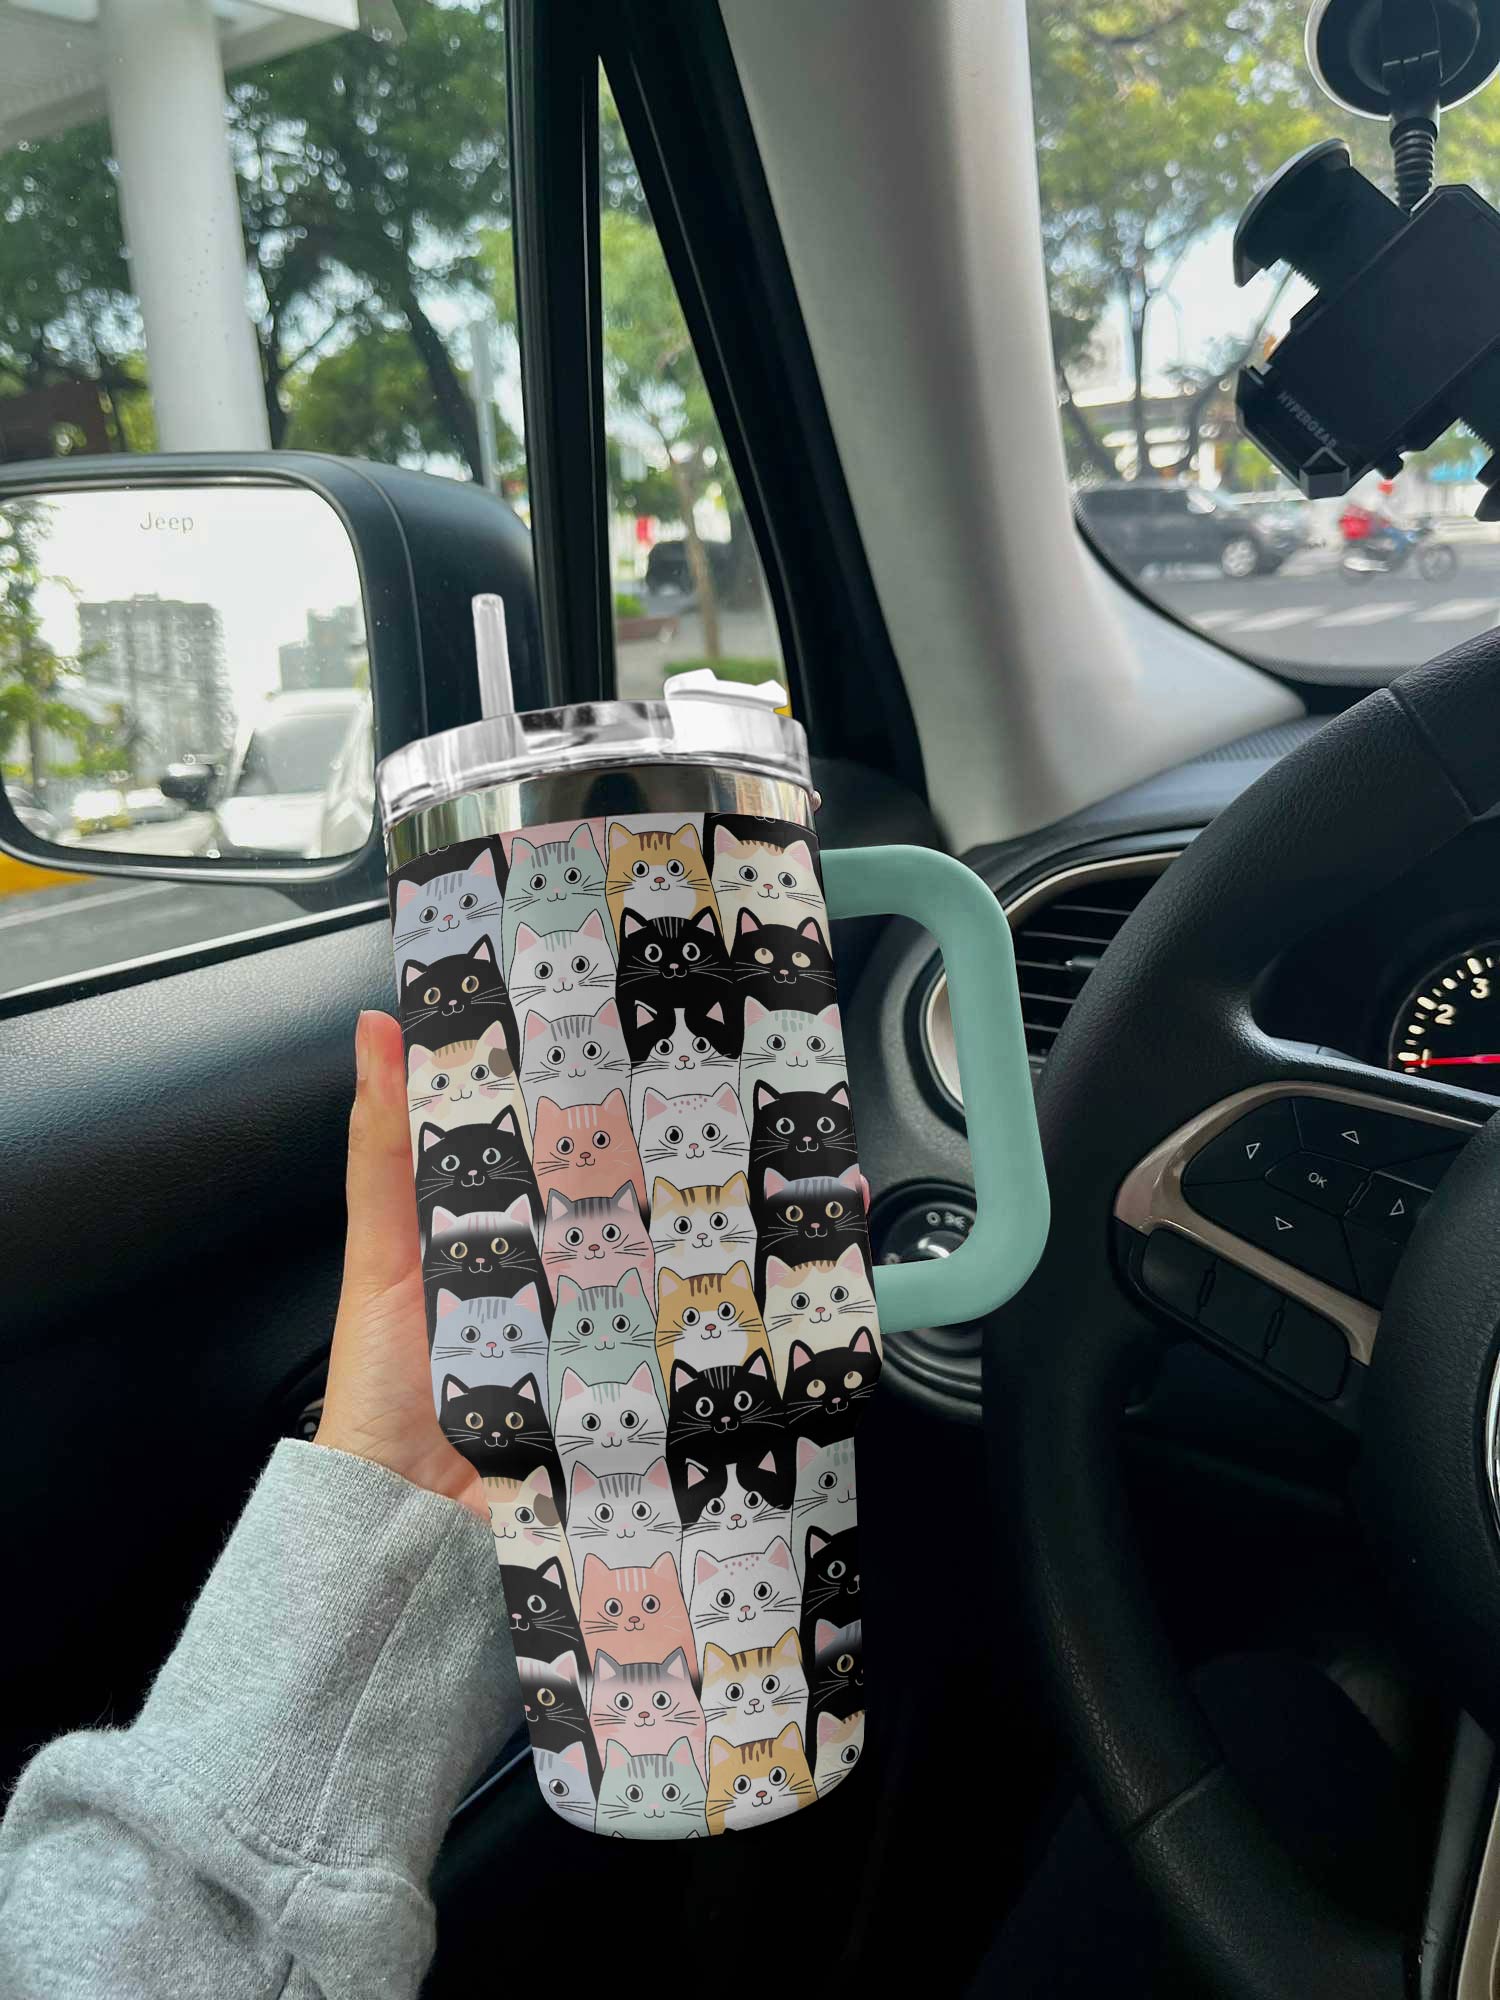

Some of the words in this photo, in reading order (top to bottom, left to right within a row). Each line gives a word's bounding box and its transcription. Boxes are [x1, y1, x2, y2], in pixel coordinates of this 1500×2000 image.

[1276, 390, 1338, 448] HYPERGEAR
[140, 511, 194, 534] Jeep
[1470, 977, 1489, 999] 3
[1435, 1004, 1454, 1026] 2
[1307, 1172, 1328, 1189] OK
